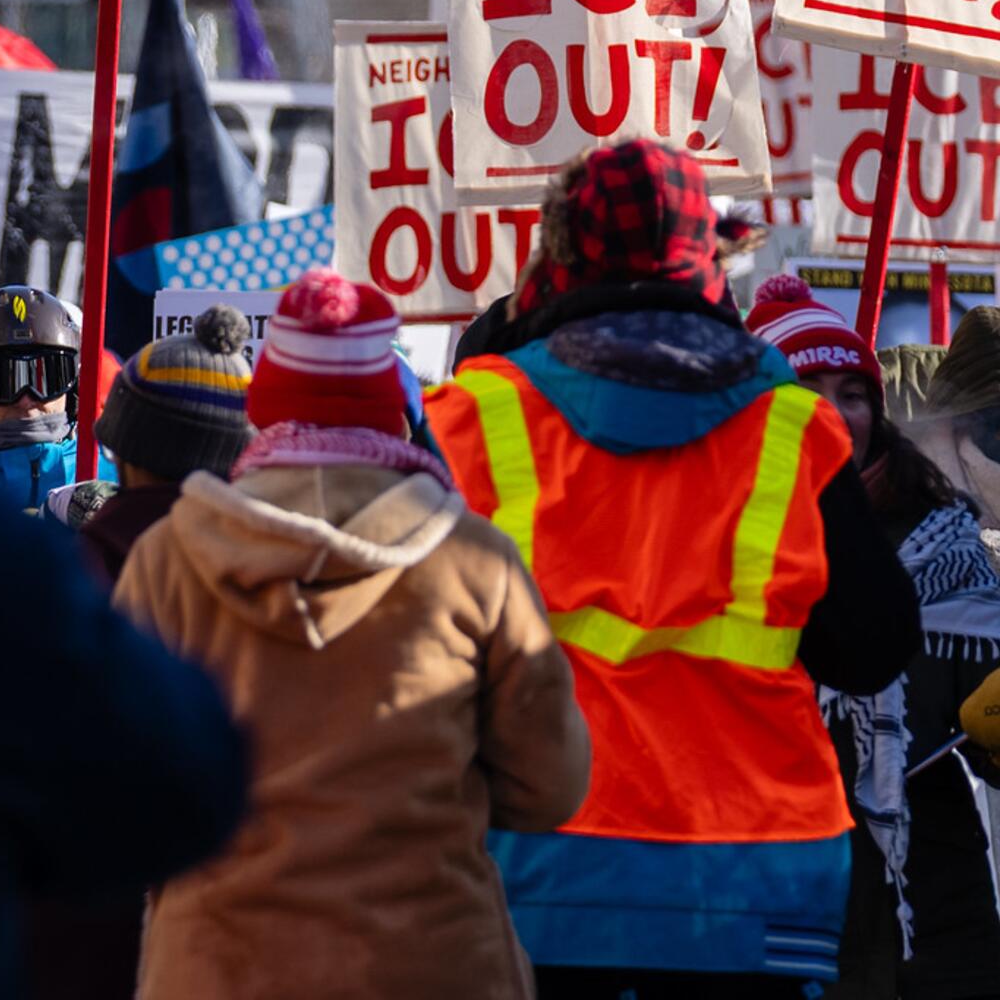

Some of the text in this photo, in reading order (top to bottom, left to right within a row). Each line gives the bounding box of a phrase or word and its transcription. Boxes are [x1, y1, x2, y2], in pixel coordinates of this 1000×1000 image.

[367, 56, 451, 88] NEIGH
[484, 38, 727, 151] OUT!
[368, 205, 542, 296] OUT
[788, 346, 861, 367] MIRAC
